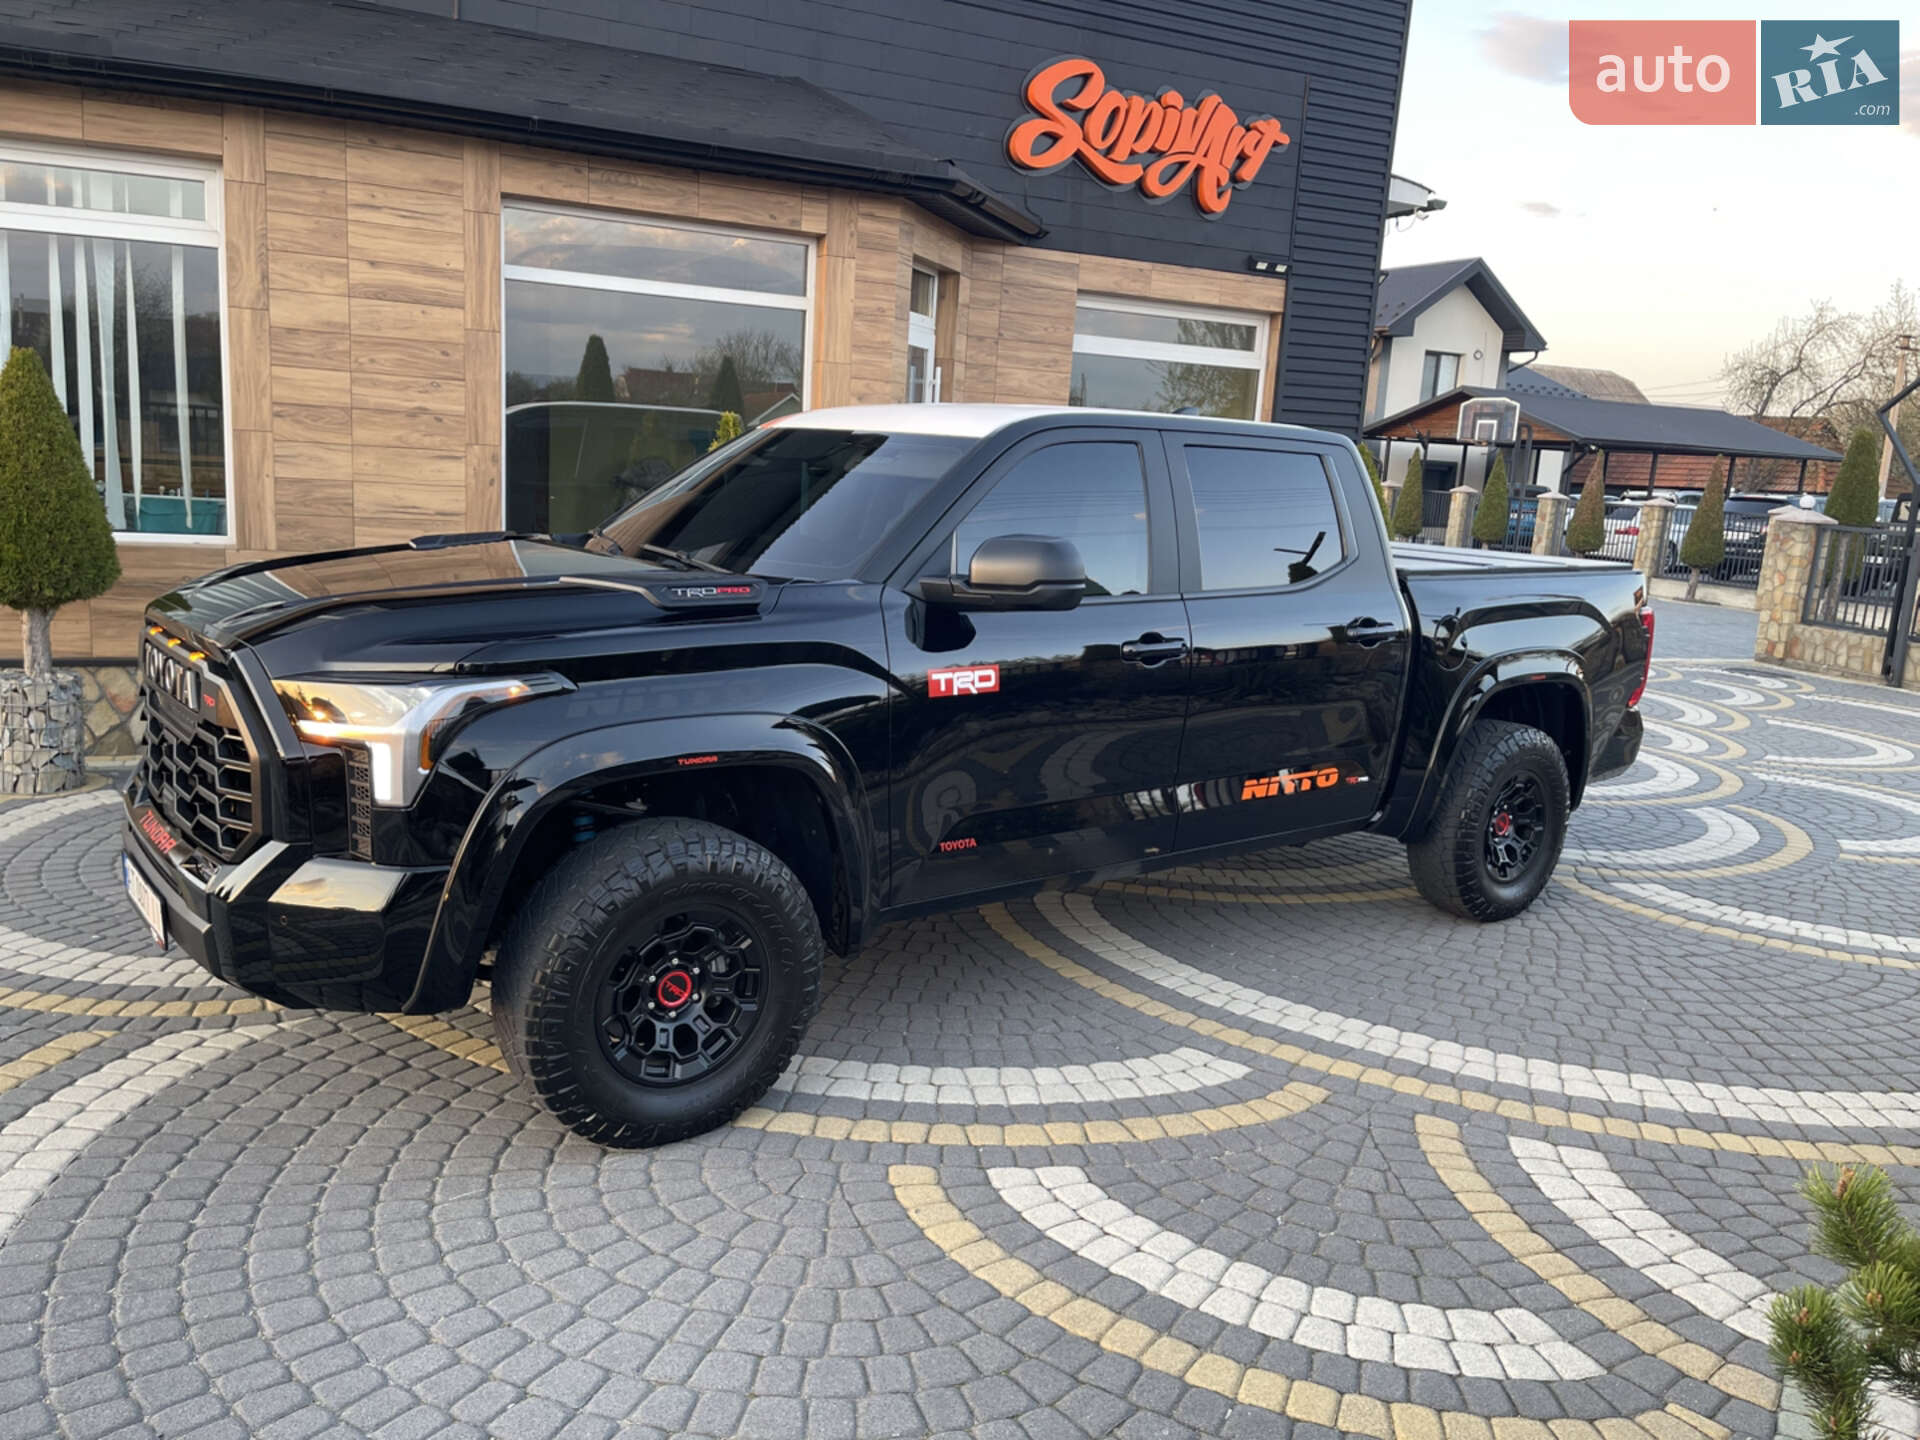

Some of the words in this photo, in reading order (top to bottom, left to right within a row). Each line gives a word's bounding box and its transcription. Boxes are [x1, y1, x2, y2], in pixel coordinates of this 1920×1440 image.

[145, 642, 199, 709] TOYOTA
[931, 669, 995, 696] TRD
[1240, 767, 1340, 801] NITTO
[939, 837, 977, 852] TOYOTA
